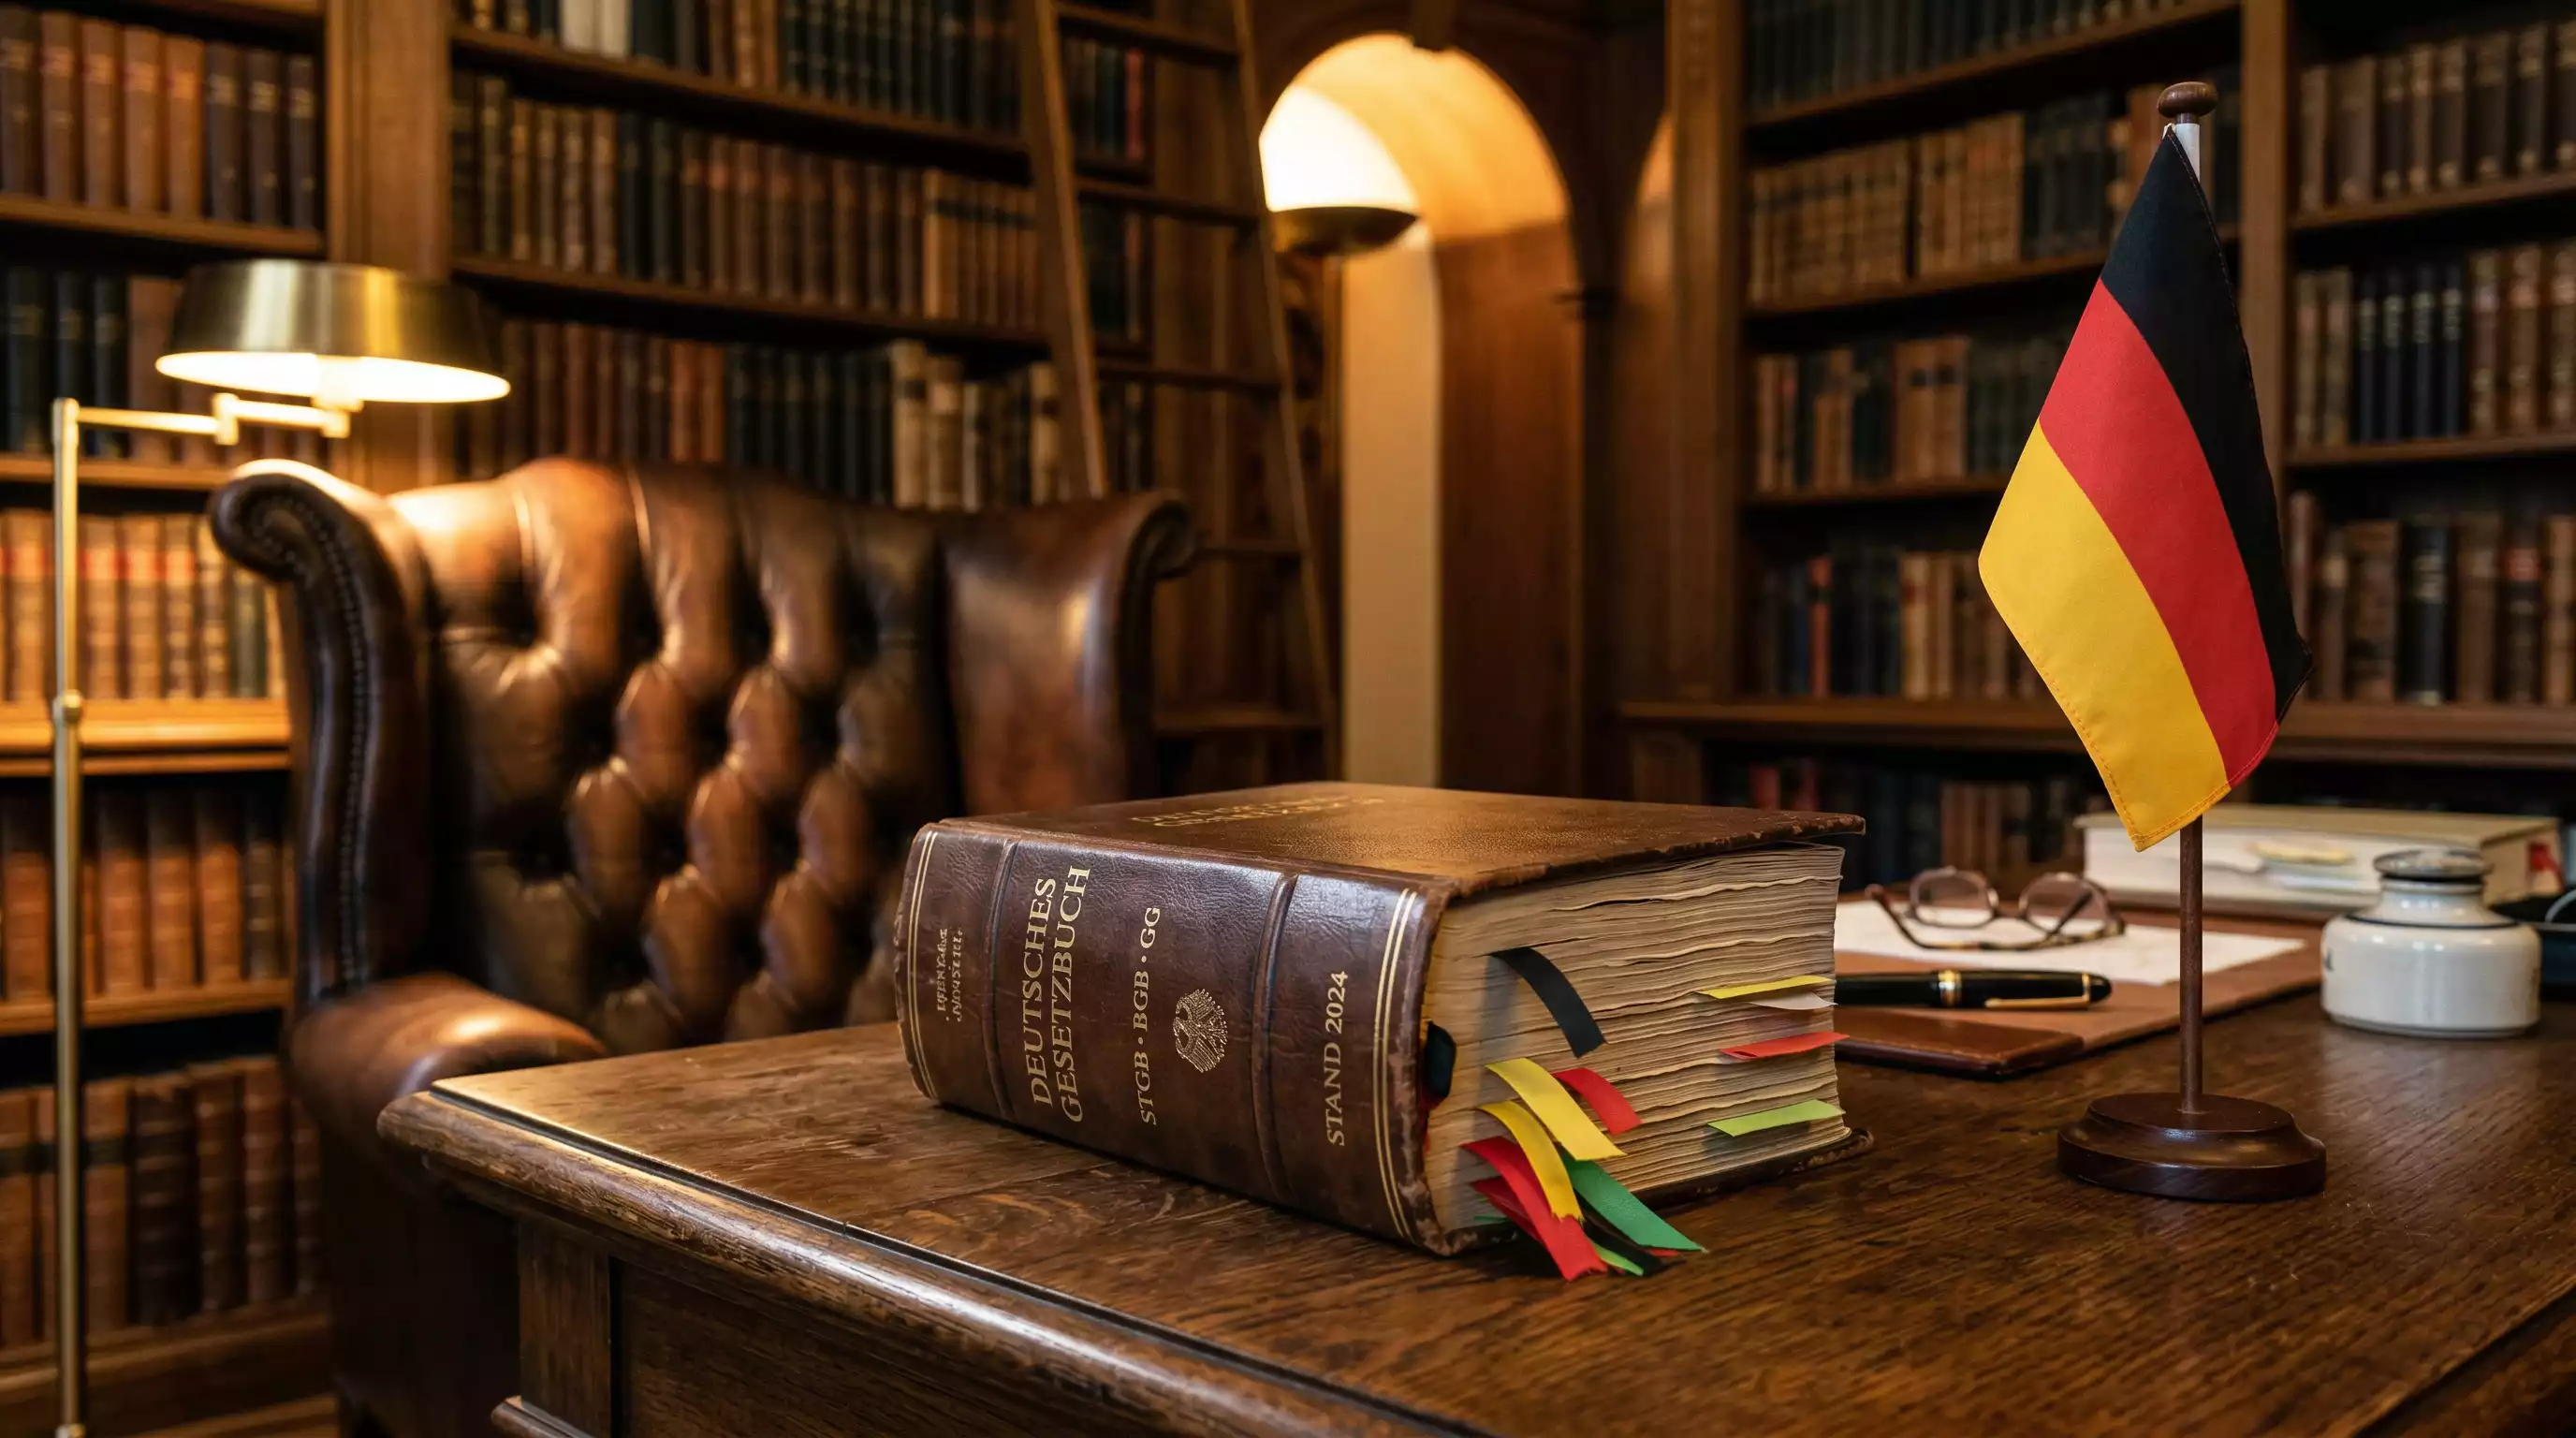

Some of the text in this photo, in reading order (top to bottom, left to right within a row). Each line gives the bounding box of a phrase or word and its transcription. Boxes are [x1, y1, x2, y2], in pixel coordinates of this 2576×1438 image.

[1022, 878, 1057, 1108] DEUTSCHES
[1051, 865, 1091, 1123] GESETZBUCH
[1133, 907, 1161, 1126] STGB BGB GG
[1324, 970, 1349, 1147] STAND 2024
